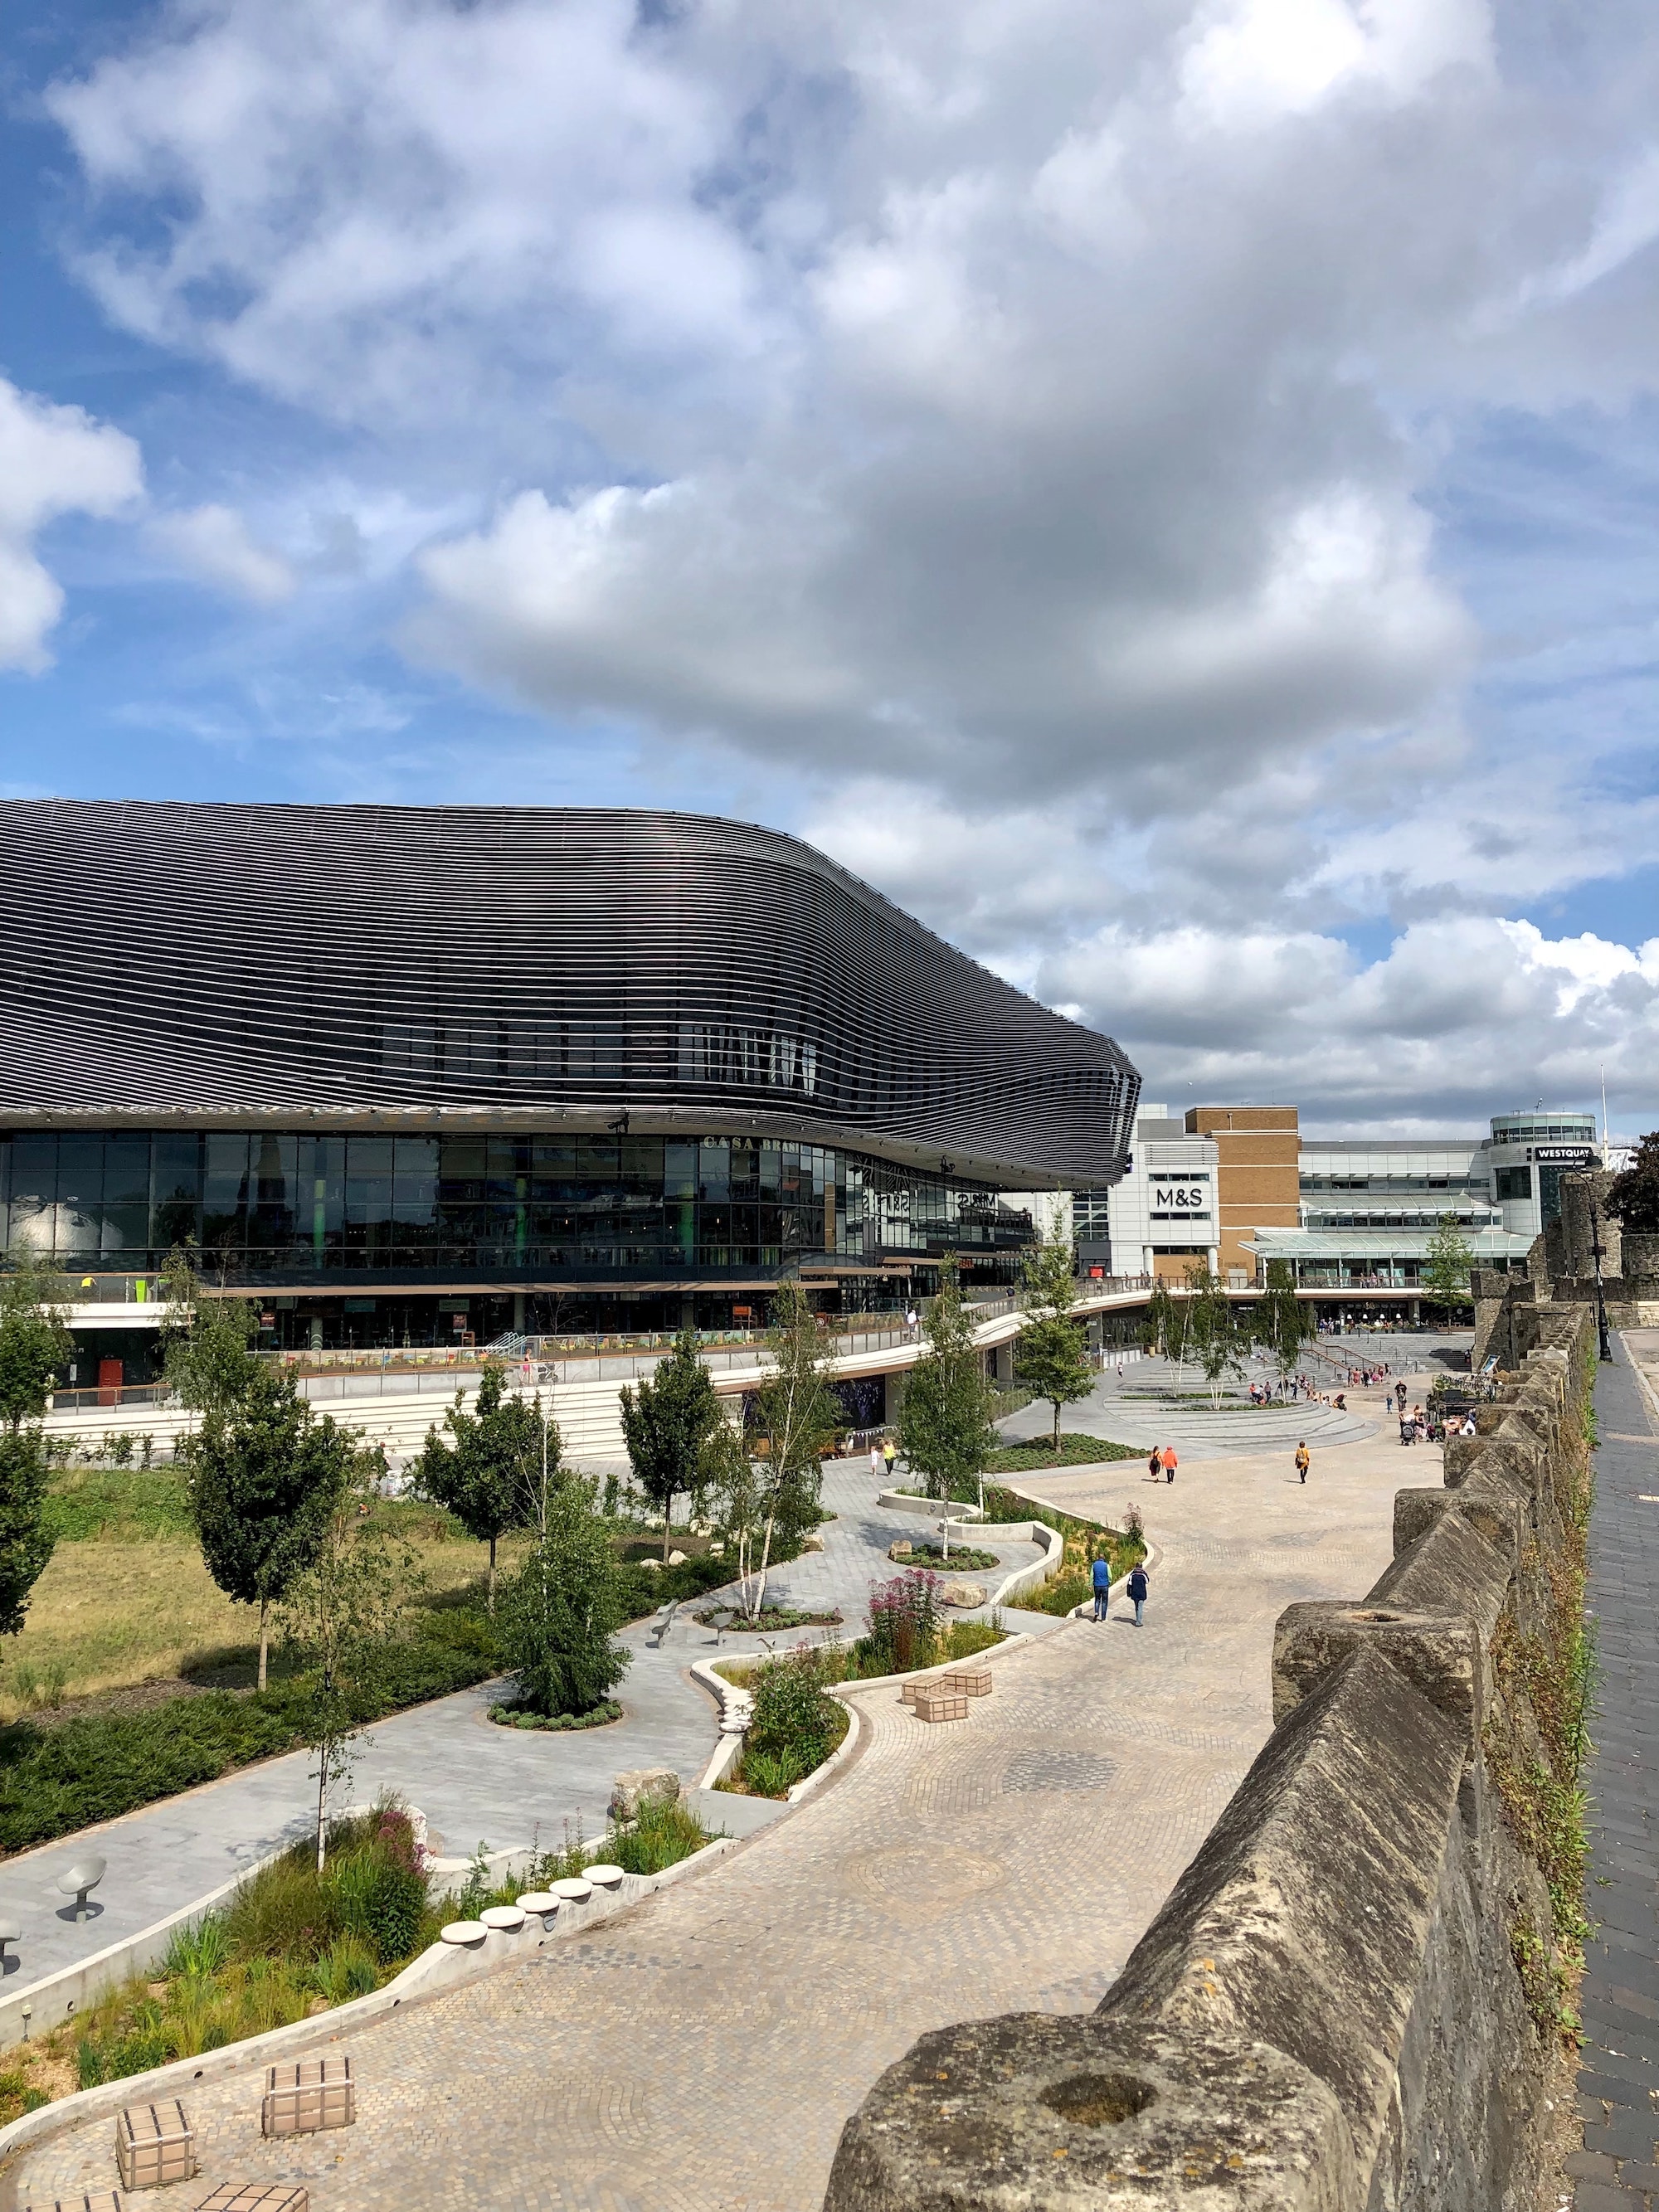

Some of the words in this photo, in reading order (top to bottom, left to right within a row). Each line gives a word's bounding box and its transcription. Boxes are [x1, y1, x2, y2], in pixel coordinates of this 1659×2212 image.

[703, 1135, 754, 1150] CASA
[1539, 1149, 1590, 1158] WESTQUAY
[1157, 1188, 1202, 1208] M&S
